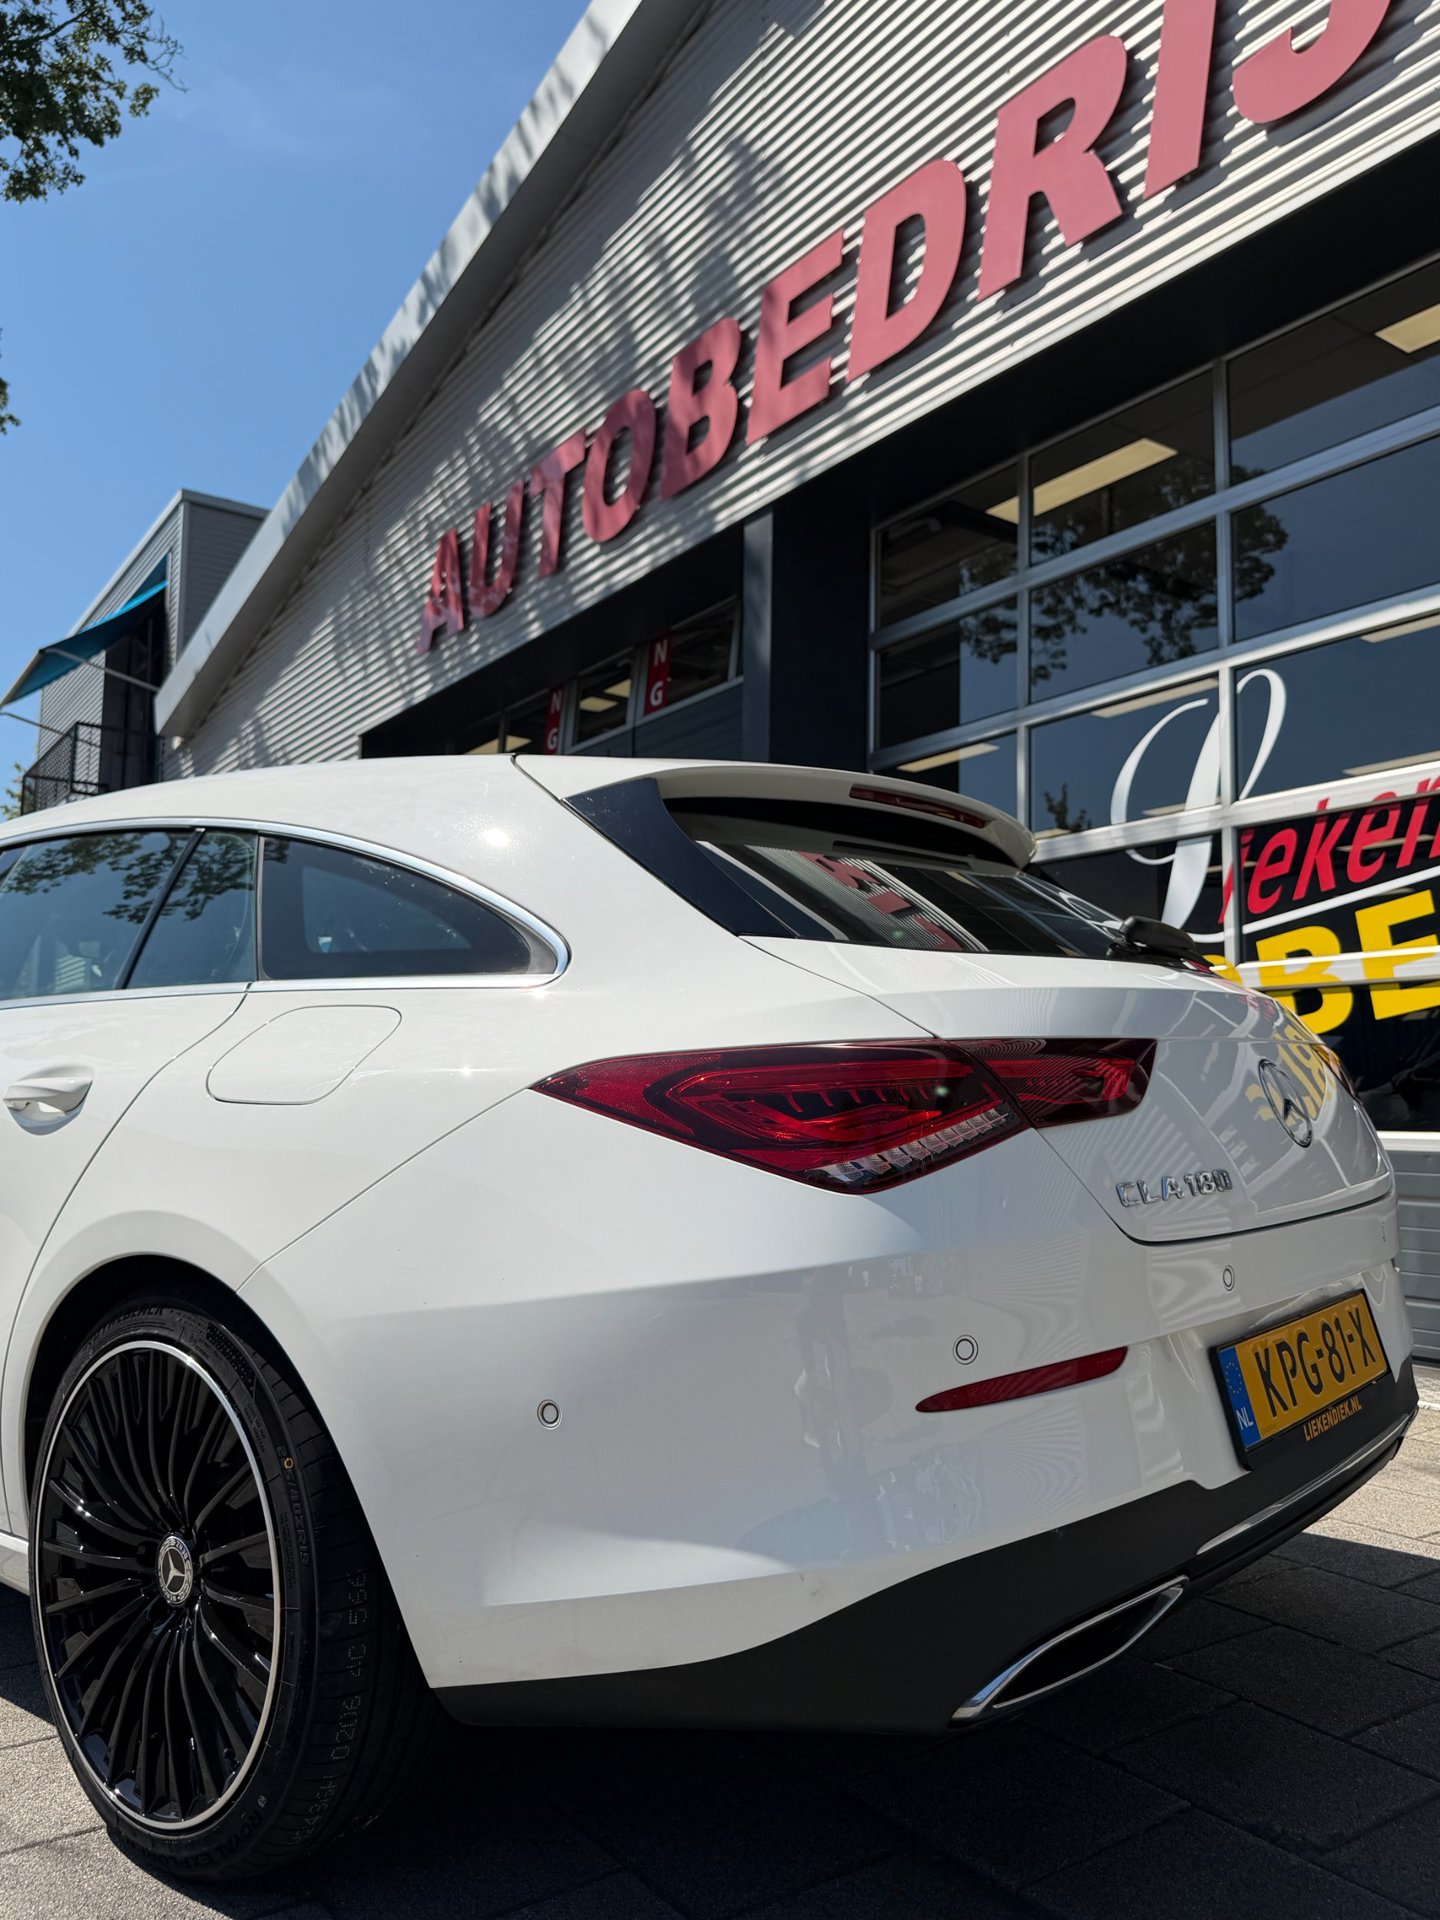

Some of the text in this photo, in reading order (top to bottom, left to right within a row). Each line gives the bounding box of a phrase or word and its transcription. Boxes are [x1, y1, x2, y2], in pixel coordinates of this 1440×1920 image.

[1203, 889, 1440, 1035] BE
[1116, 1168, 1233, 1207] CLA 180
[1254, 1306, 1376, 1418] KPG-81-X
[1236, 1406, 1254, 1431] NL
[1303, 1395, 1363, 1442] LIEKENDIEK.NL
[214, 1810, 264, 1861] ROYAL
